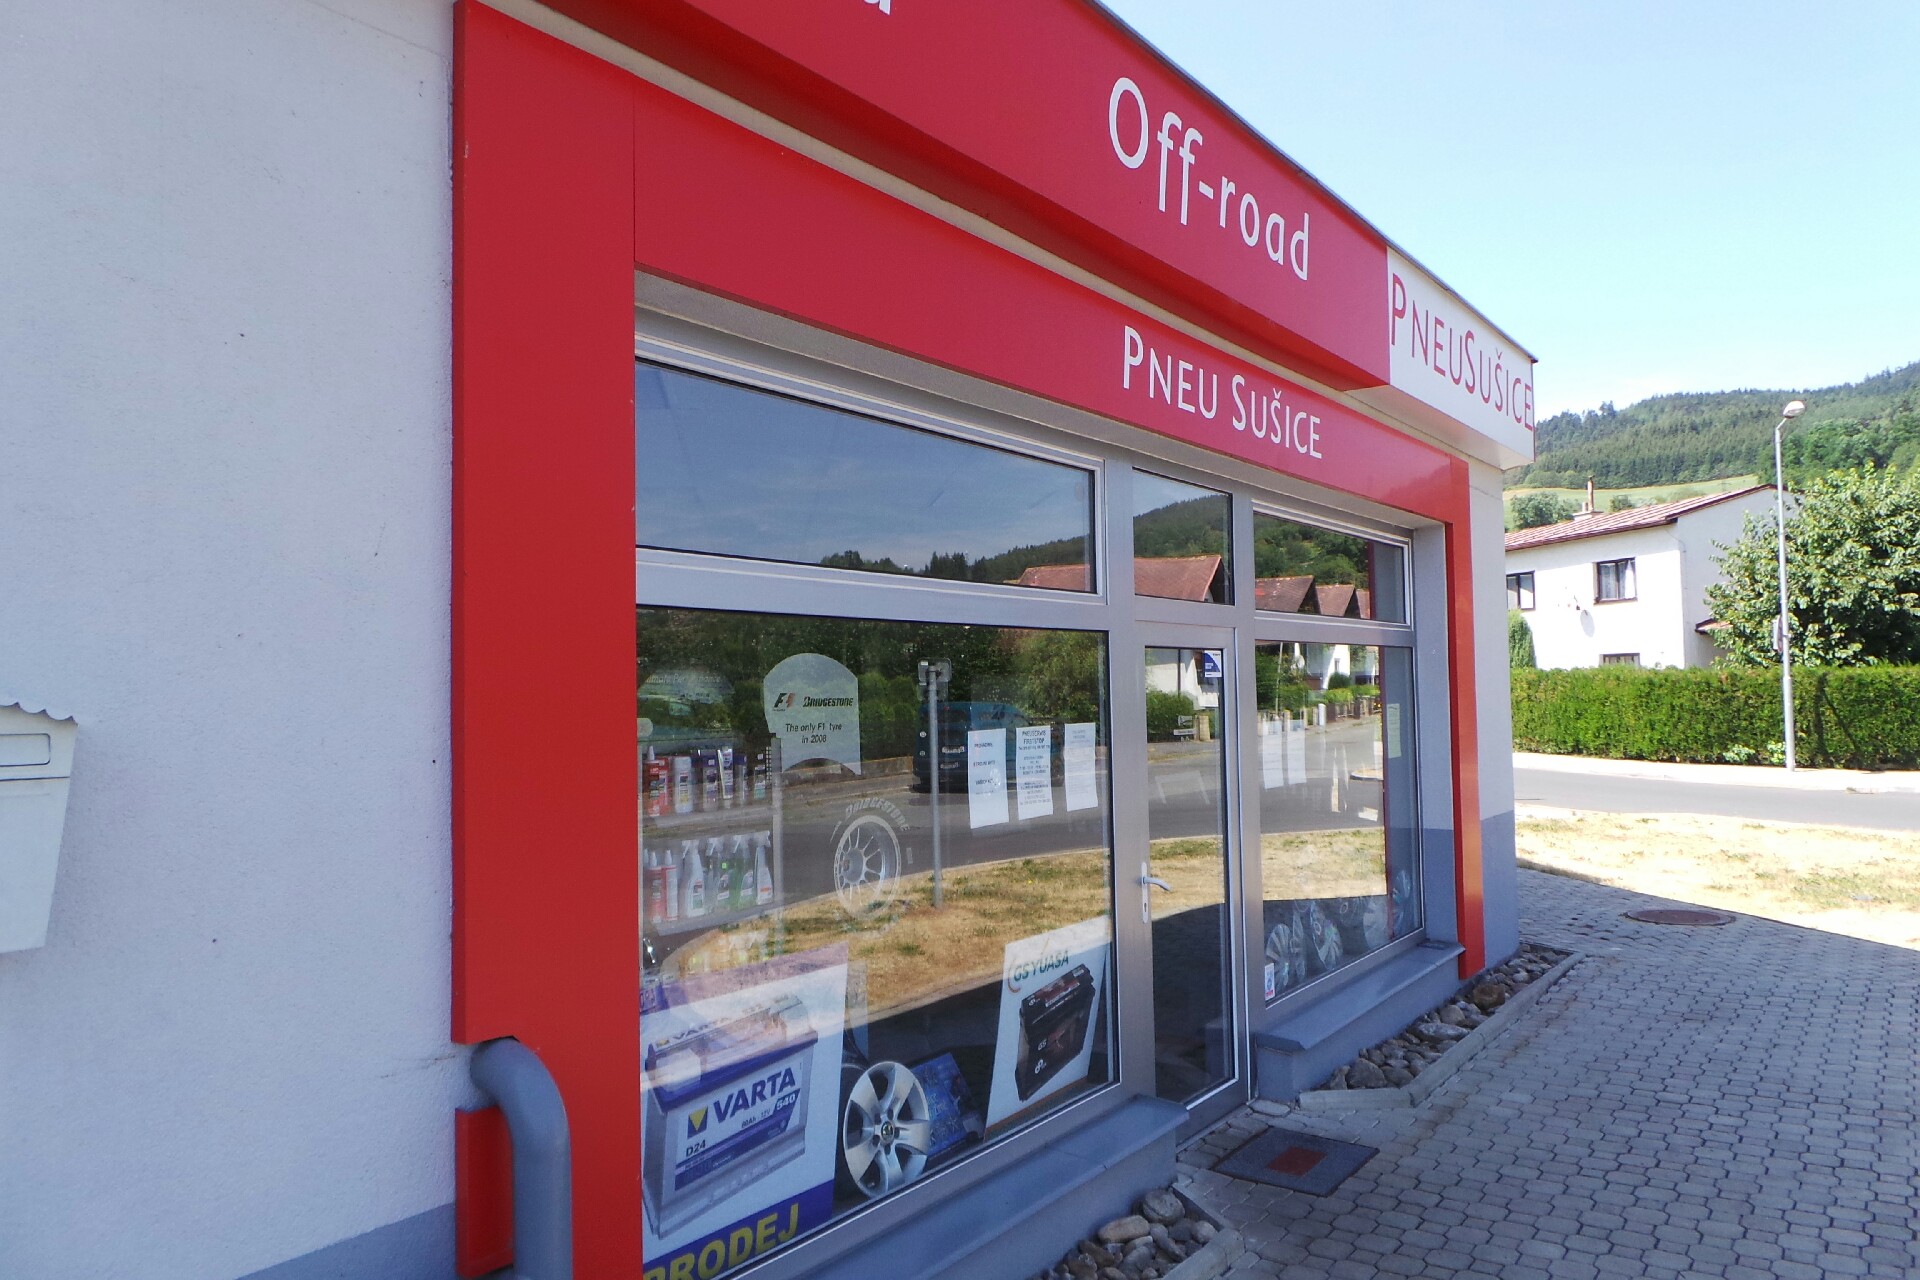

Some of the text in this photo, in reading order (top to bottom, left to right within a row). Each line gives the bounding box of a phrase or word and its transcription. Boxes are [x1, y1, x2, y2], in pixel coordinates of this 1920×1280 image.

[1109, 77, 1309, 281] Off-road
[1123, 325, 1322, 460] PNEU SUŠICE
[803, 696, 854, 708] BRIDGESTONE
[785, 722, 843, 734] The only F1 tyre
[801, 735, 827, 744] in 2008
[1013, 950, 1069, 982] GS YUASA
[713, 1067, 796, 1124] VARTA
[686, 1140, 706, 1157] D24
